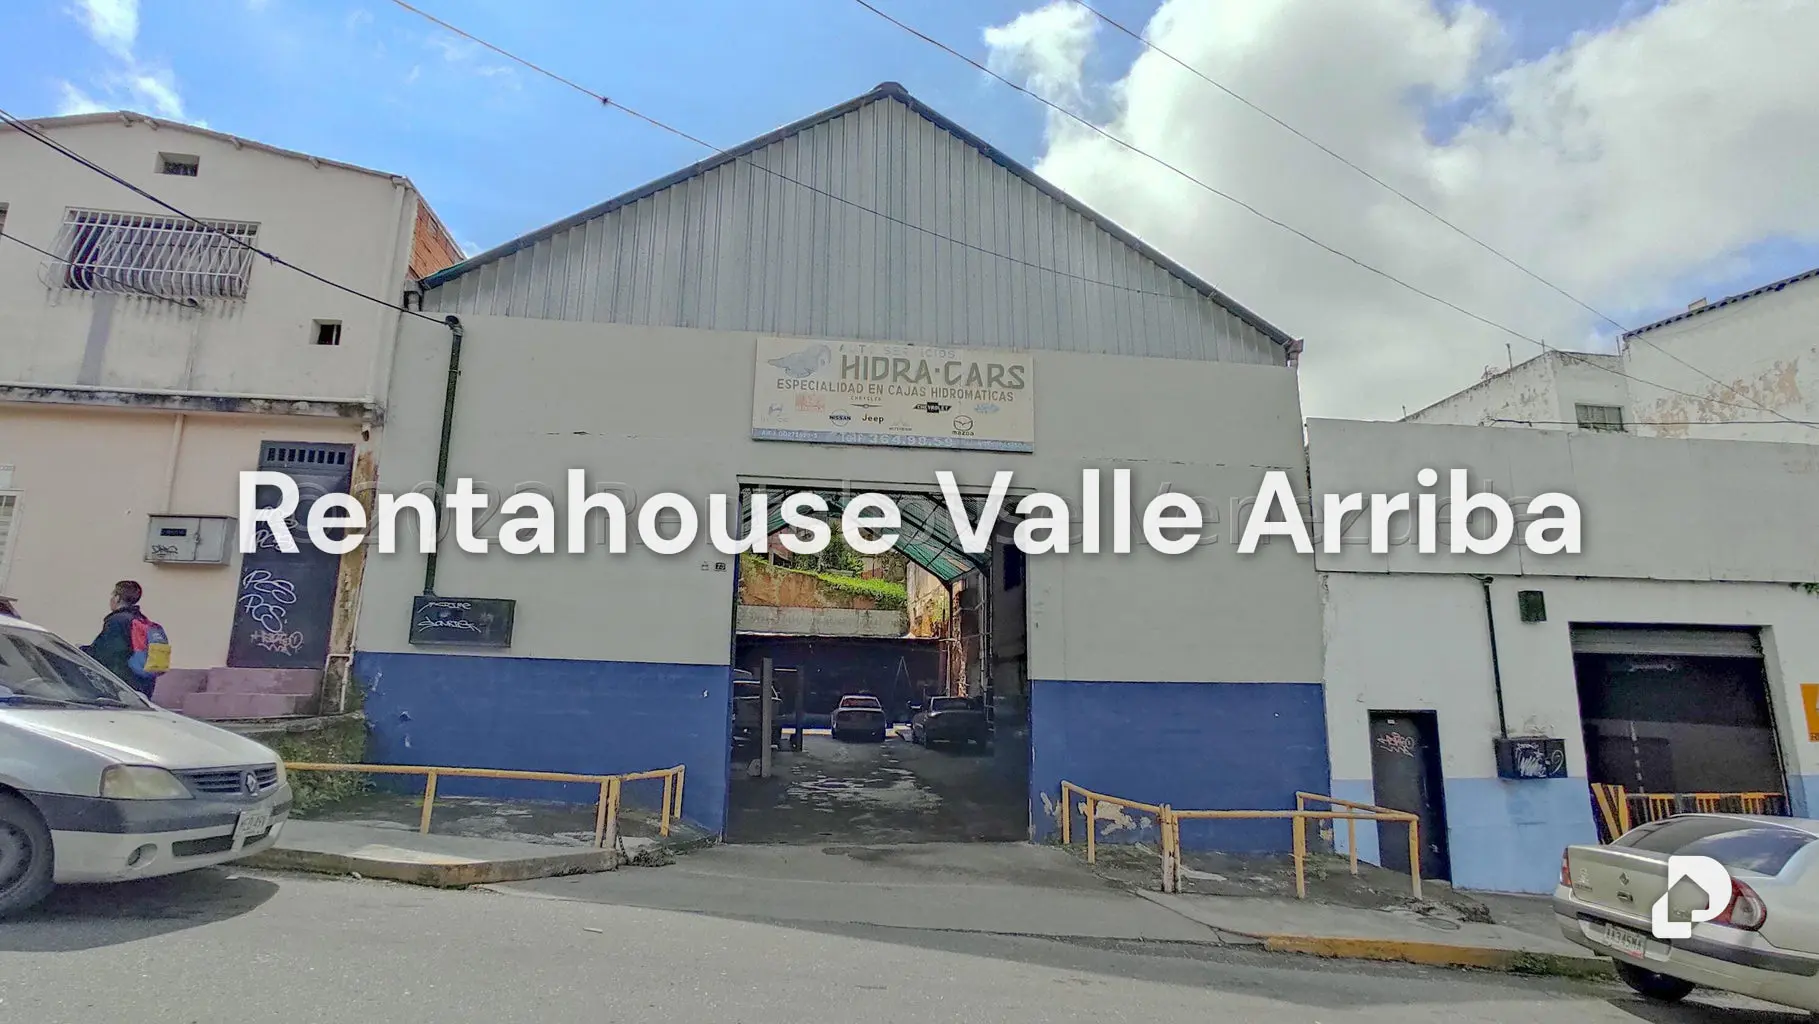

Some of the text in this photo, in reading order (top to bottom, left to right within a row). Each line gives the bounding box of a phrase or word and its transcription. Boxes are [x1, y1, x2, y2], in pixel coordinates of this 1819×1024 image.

[776, 378, 865, 394] ESPECIALIDAD
[868, 383, 884, 396] EN
[888, 385, 927, 398] CAJAS
[862, 413, 885, 424] Jeep
